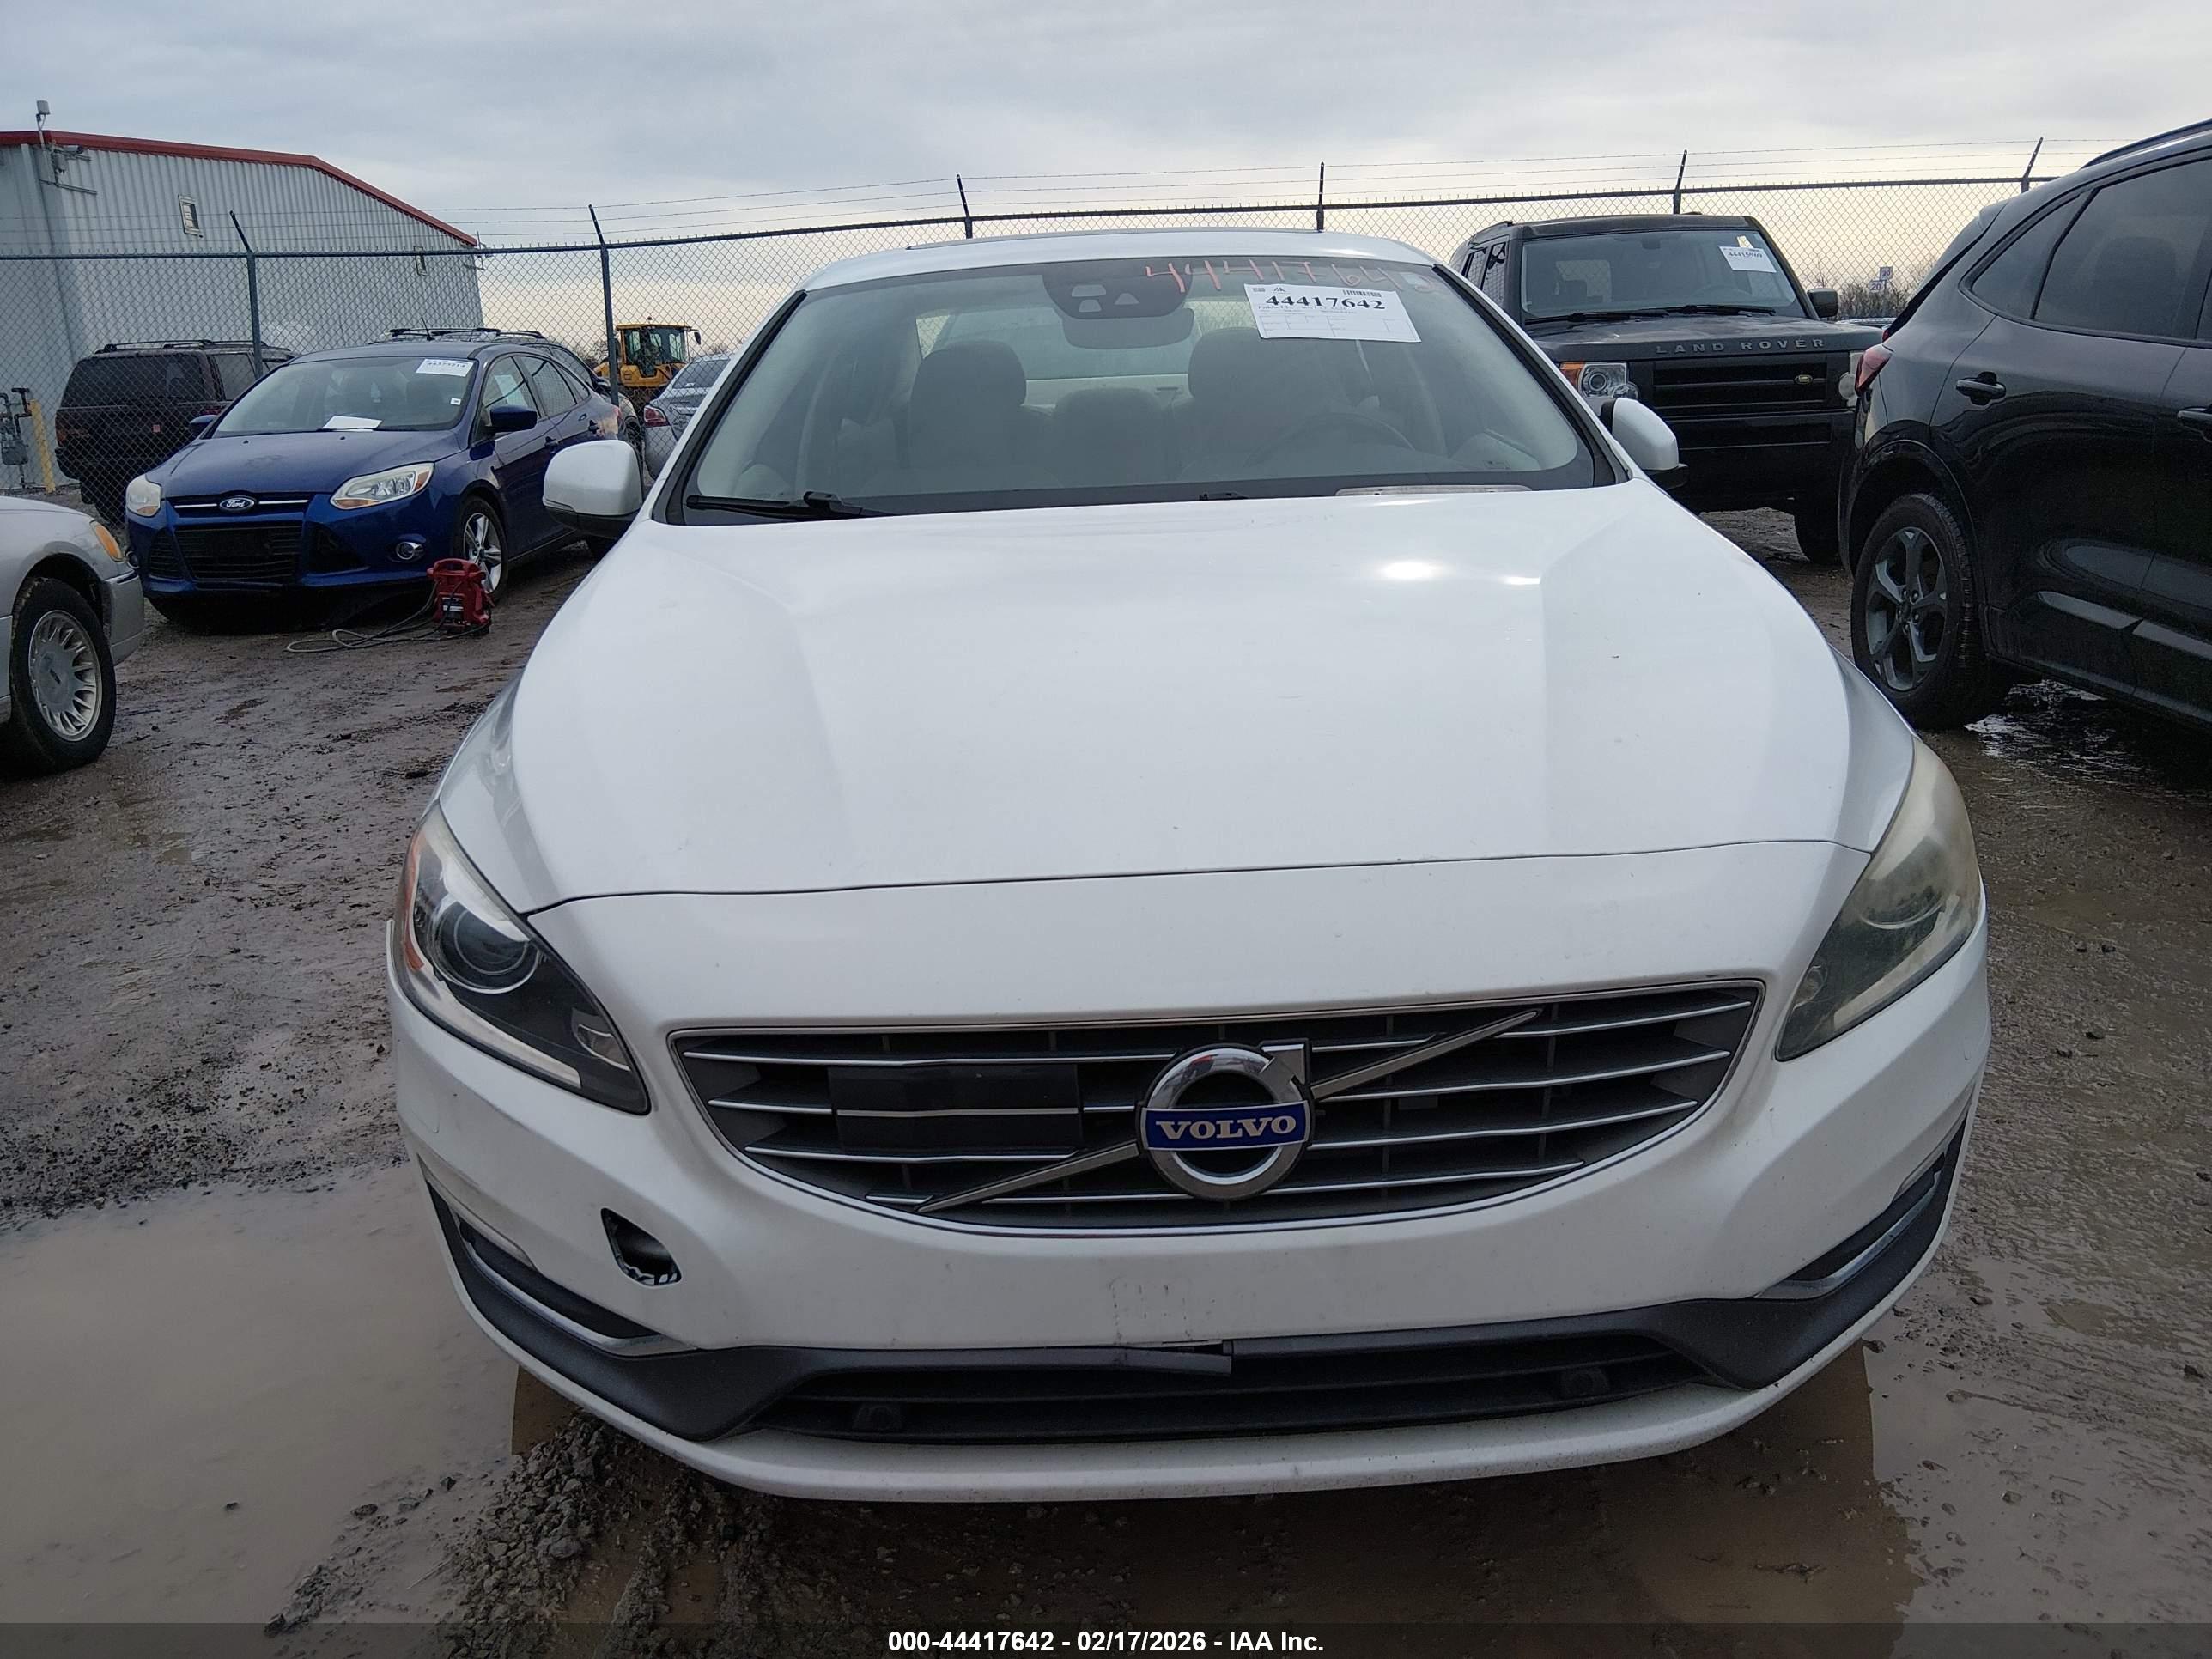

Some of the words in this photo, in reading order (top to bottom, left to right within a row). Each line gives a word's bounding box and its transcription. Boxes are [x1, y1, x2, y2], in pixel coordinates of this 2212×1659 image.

[1265, 295, 1386, 310] 44417642
[1656, 343, 1724, 354] LAND
[1741, 339, 1825, 350] ROVER
[226, 499, 246, 507] Ford
[1155, 1115, 1297, 1140] VOLVO
